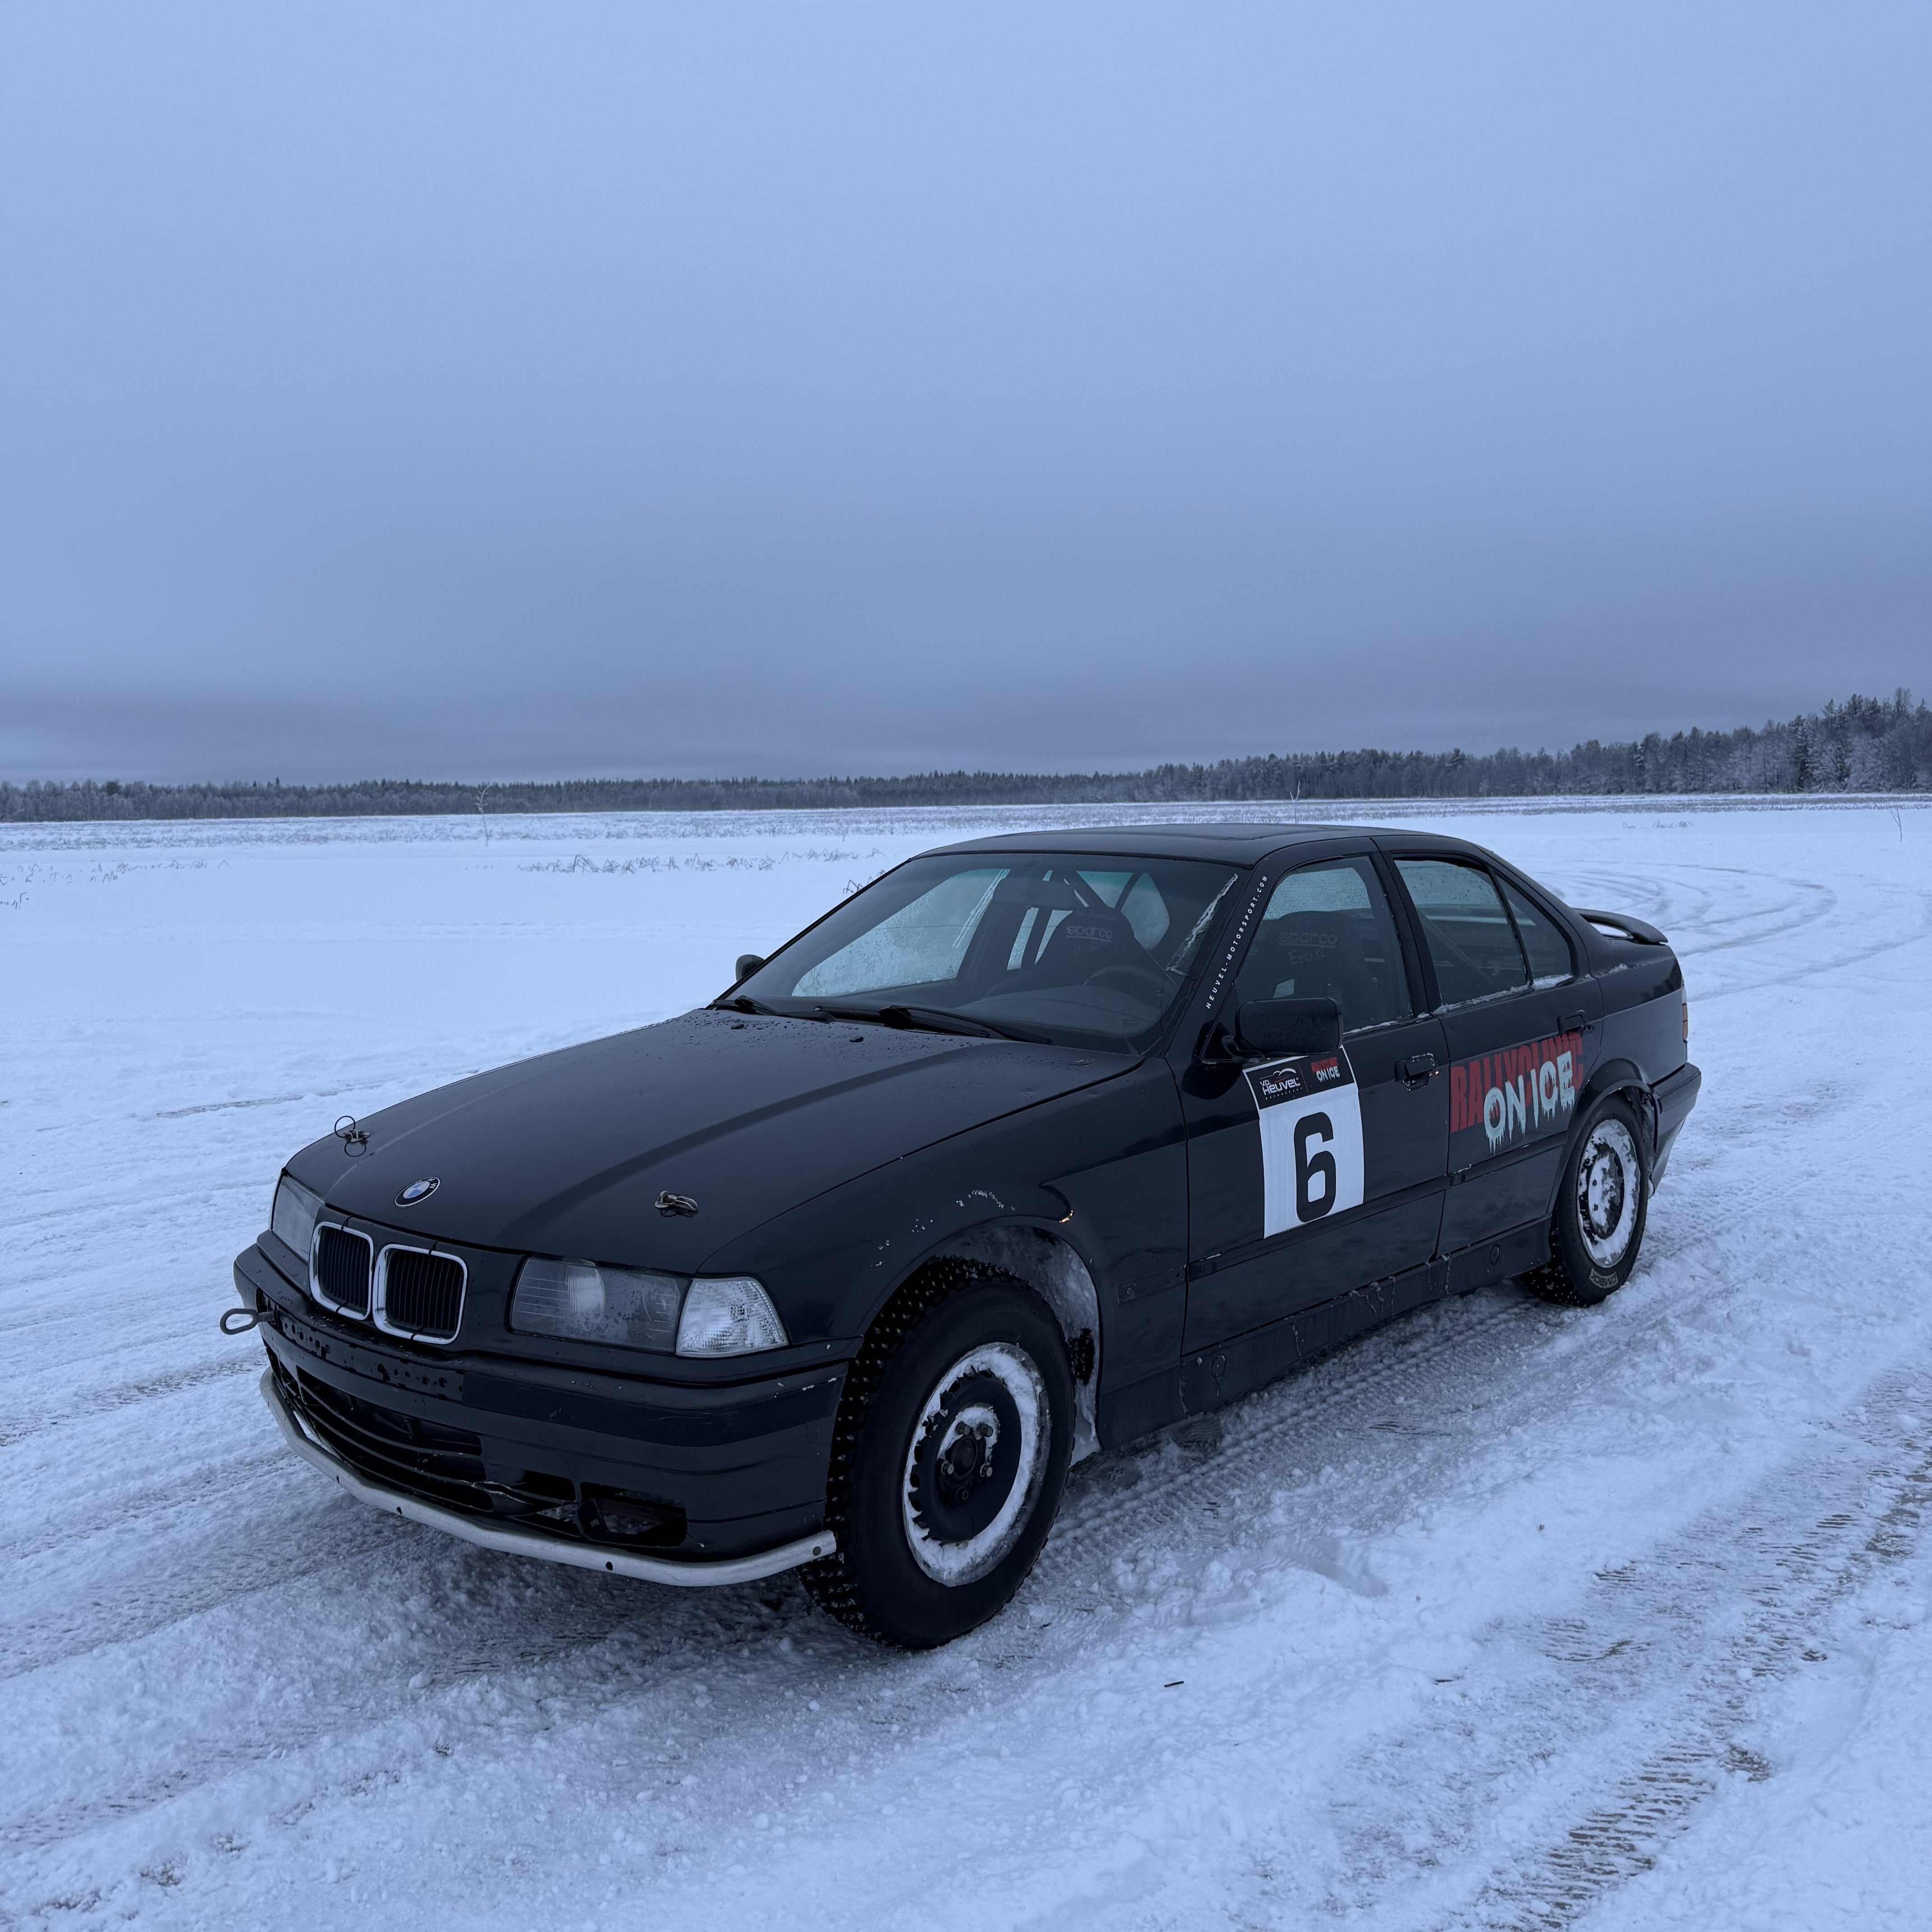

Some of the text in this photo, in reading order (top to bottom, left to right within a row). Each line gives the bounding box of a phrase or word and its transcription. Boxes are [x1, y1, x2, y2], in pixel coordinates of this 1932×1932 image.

[1484, 1050, 1575, 1155] ON ICE
[1293, 1112, 1336, 1223] 6
